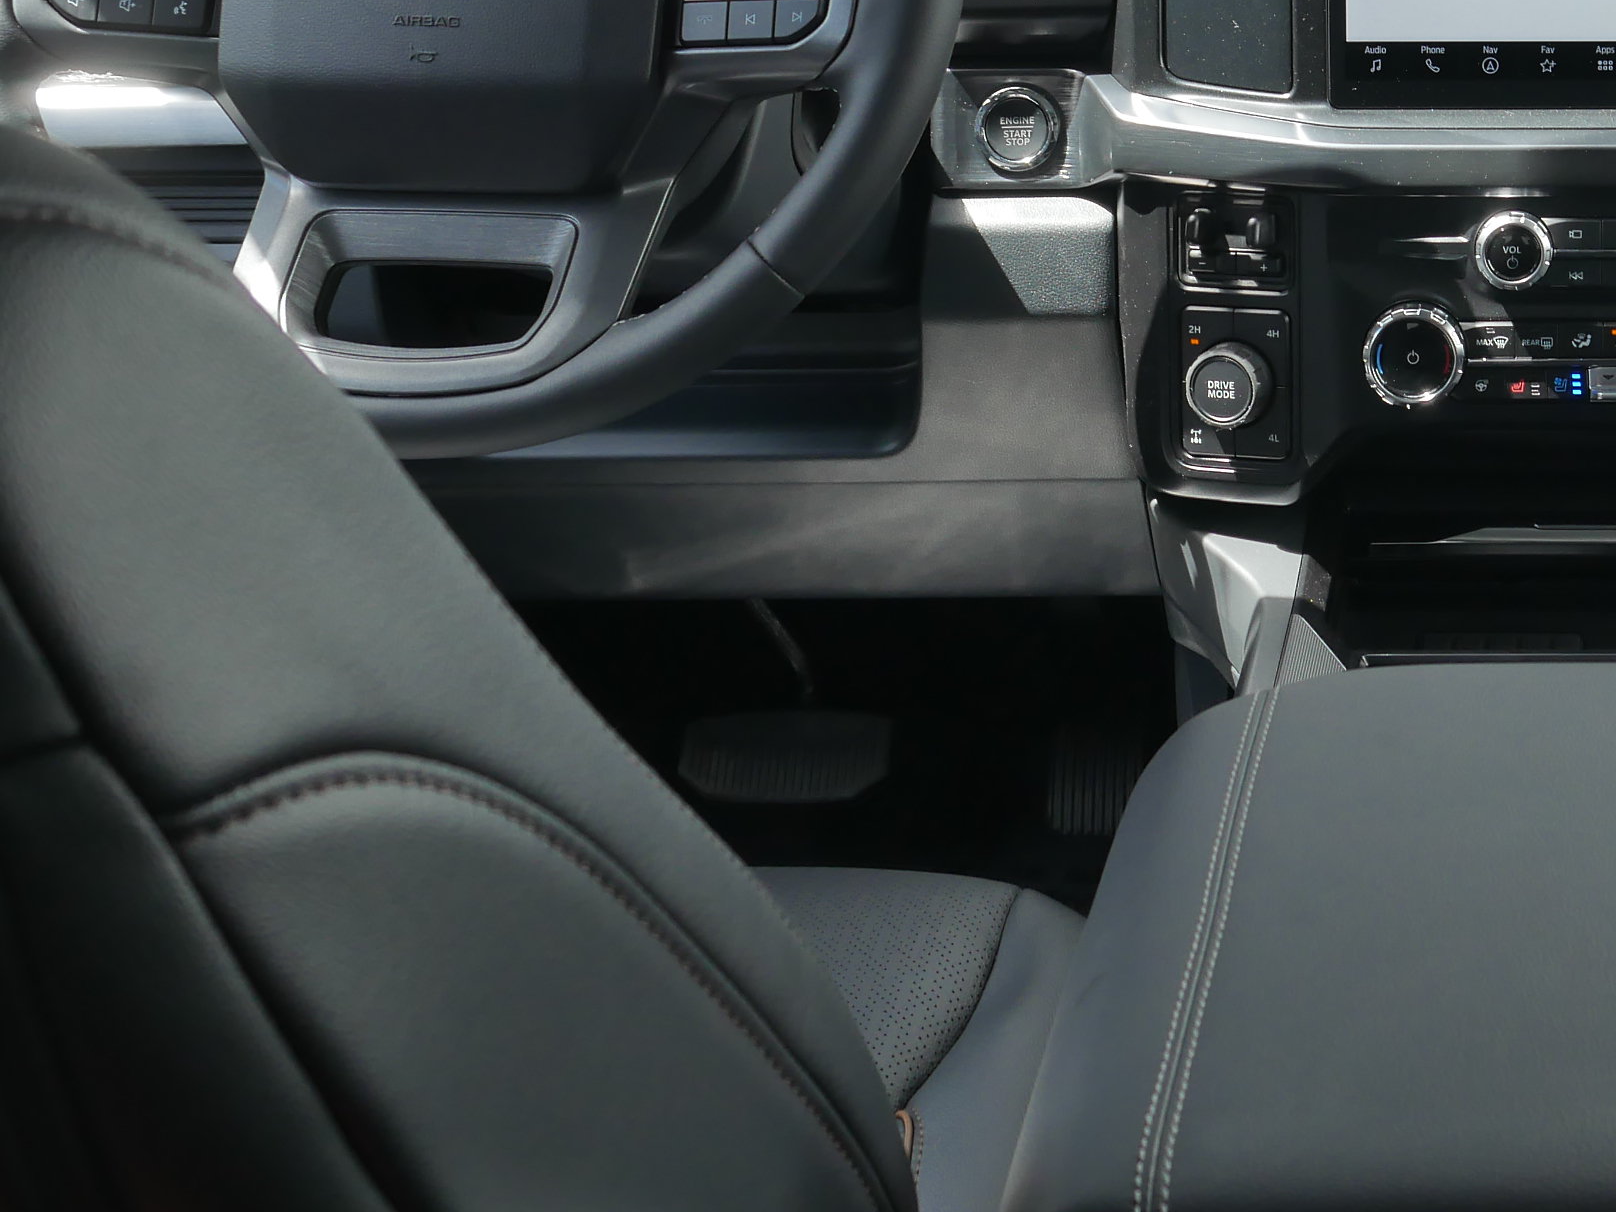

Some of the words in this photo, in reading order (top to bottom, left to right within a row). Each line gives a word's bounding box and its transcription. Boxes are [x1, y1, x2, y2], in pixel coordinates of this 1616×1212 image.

[392, 14, 462, 28] AIRBAG
[1364, 45, 1387, 55] Audio
[1420, 45, 1445, 55] Phone
[1482, 45, 1498, 55] Nav
[1541, 45, 1555, 55] Fav
[1595, 45, 1615, 57] Apps
[1000, 116, 1035, 125] ENGINE
[1003, 130, 1032, 138] START
[1005, 138, 1030, 146] STOP
[1502, 245, 1521, 255] VOL
[1188, 325, 1201, 335] 2H
[1266, 330, 1280, 339] 4H
[1476, 338, 1494, 347] MAX
[1522, 339, 1541, 347] REAR
[1207, 380, 1235, 390] DRIVE
[1207, 389, 1236, 399] MODE
[1268, 434, 1280, 443] 4L
